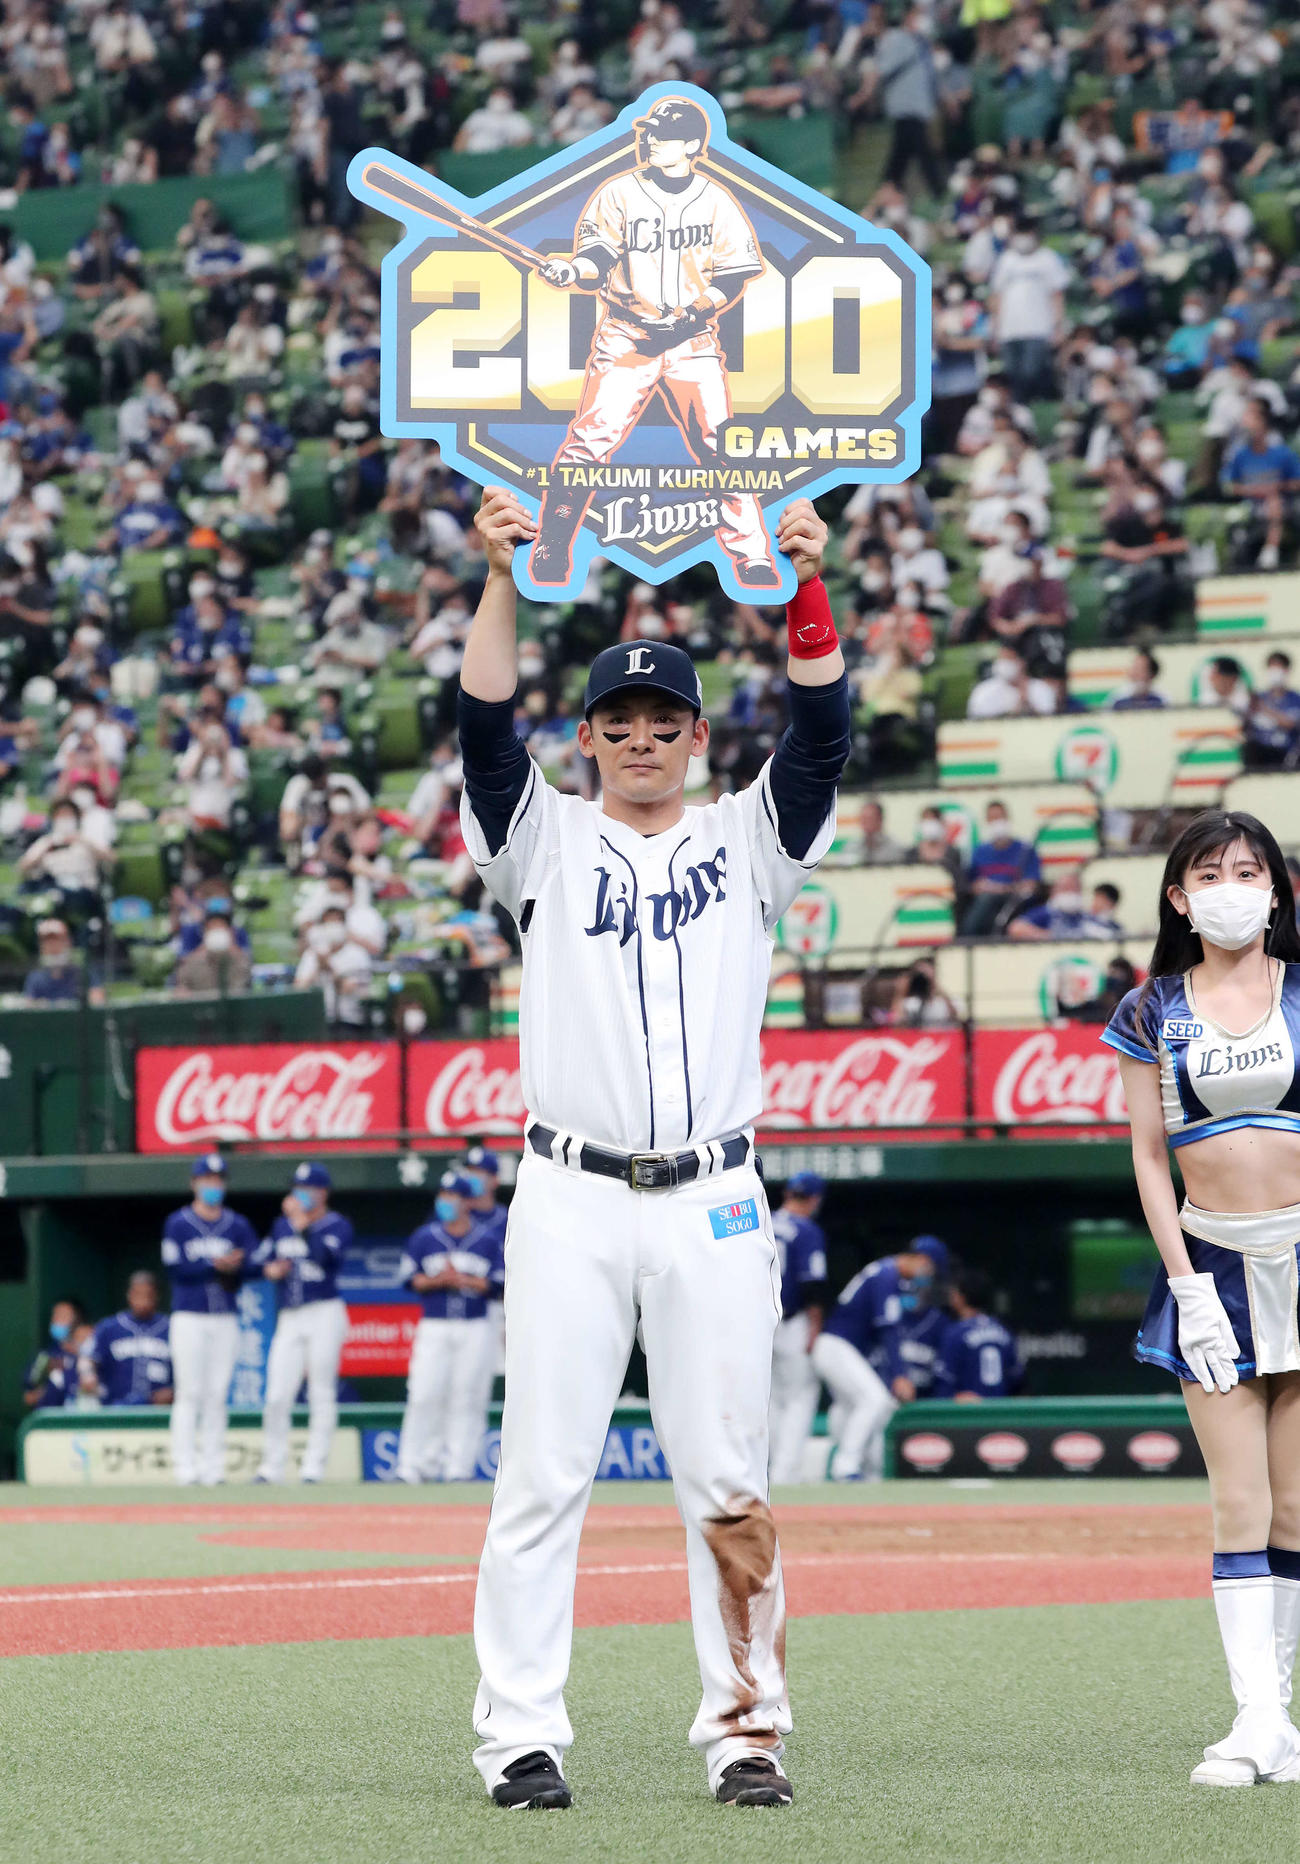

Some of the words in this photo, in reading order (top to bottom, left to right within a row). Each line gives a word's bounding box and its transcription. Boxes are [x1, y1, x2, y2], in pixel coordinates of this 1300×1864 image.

[627, 216, 713, 254] Lions
[724, 426, 897, 460] GAMES
[526, 466, 550, 487] #1
[559, 466, 651, 488] TAKUMI
[658, 469, 784, 490] KURIYAMA
[602, 493, 721, 544] Lions
[624, 647, 656, 676] L
[1166, 1021, 1204, 1039] SEED
[1196, 1042, 1284, 1079] Lions
[718, 1202, 752, 1220] SEIBU
[725, 1218, 753, 1234] SOGO
